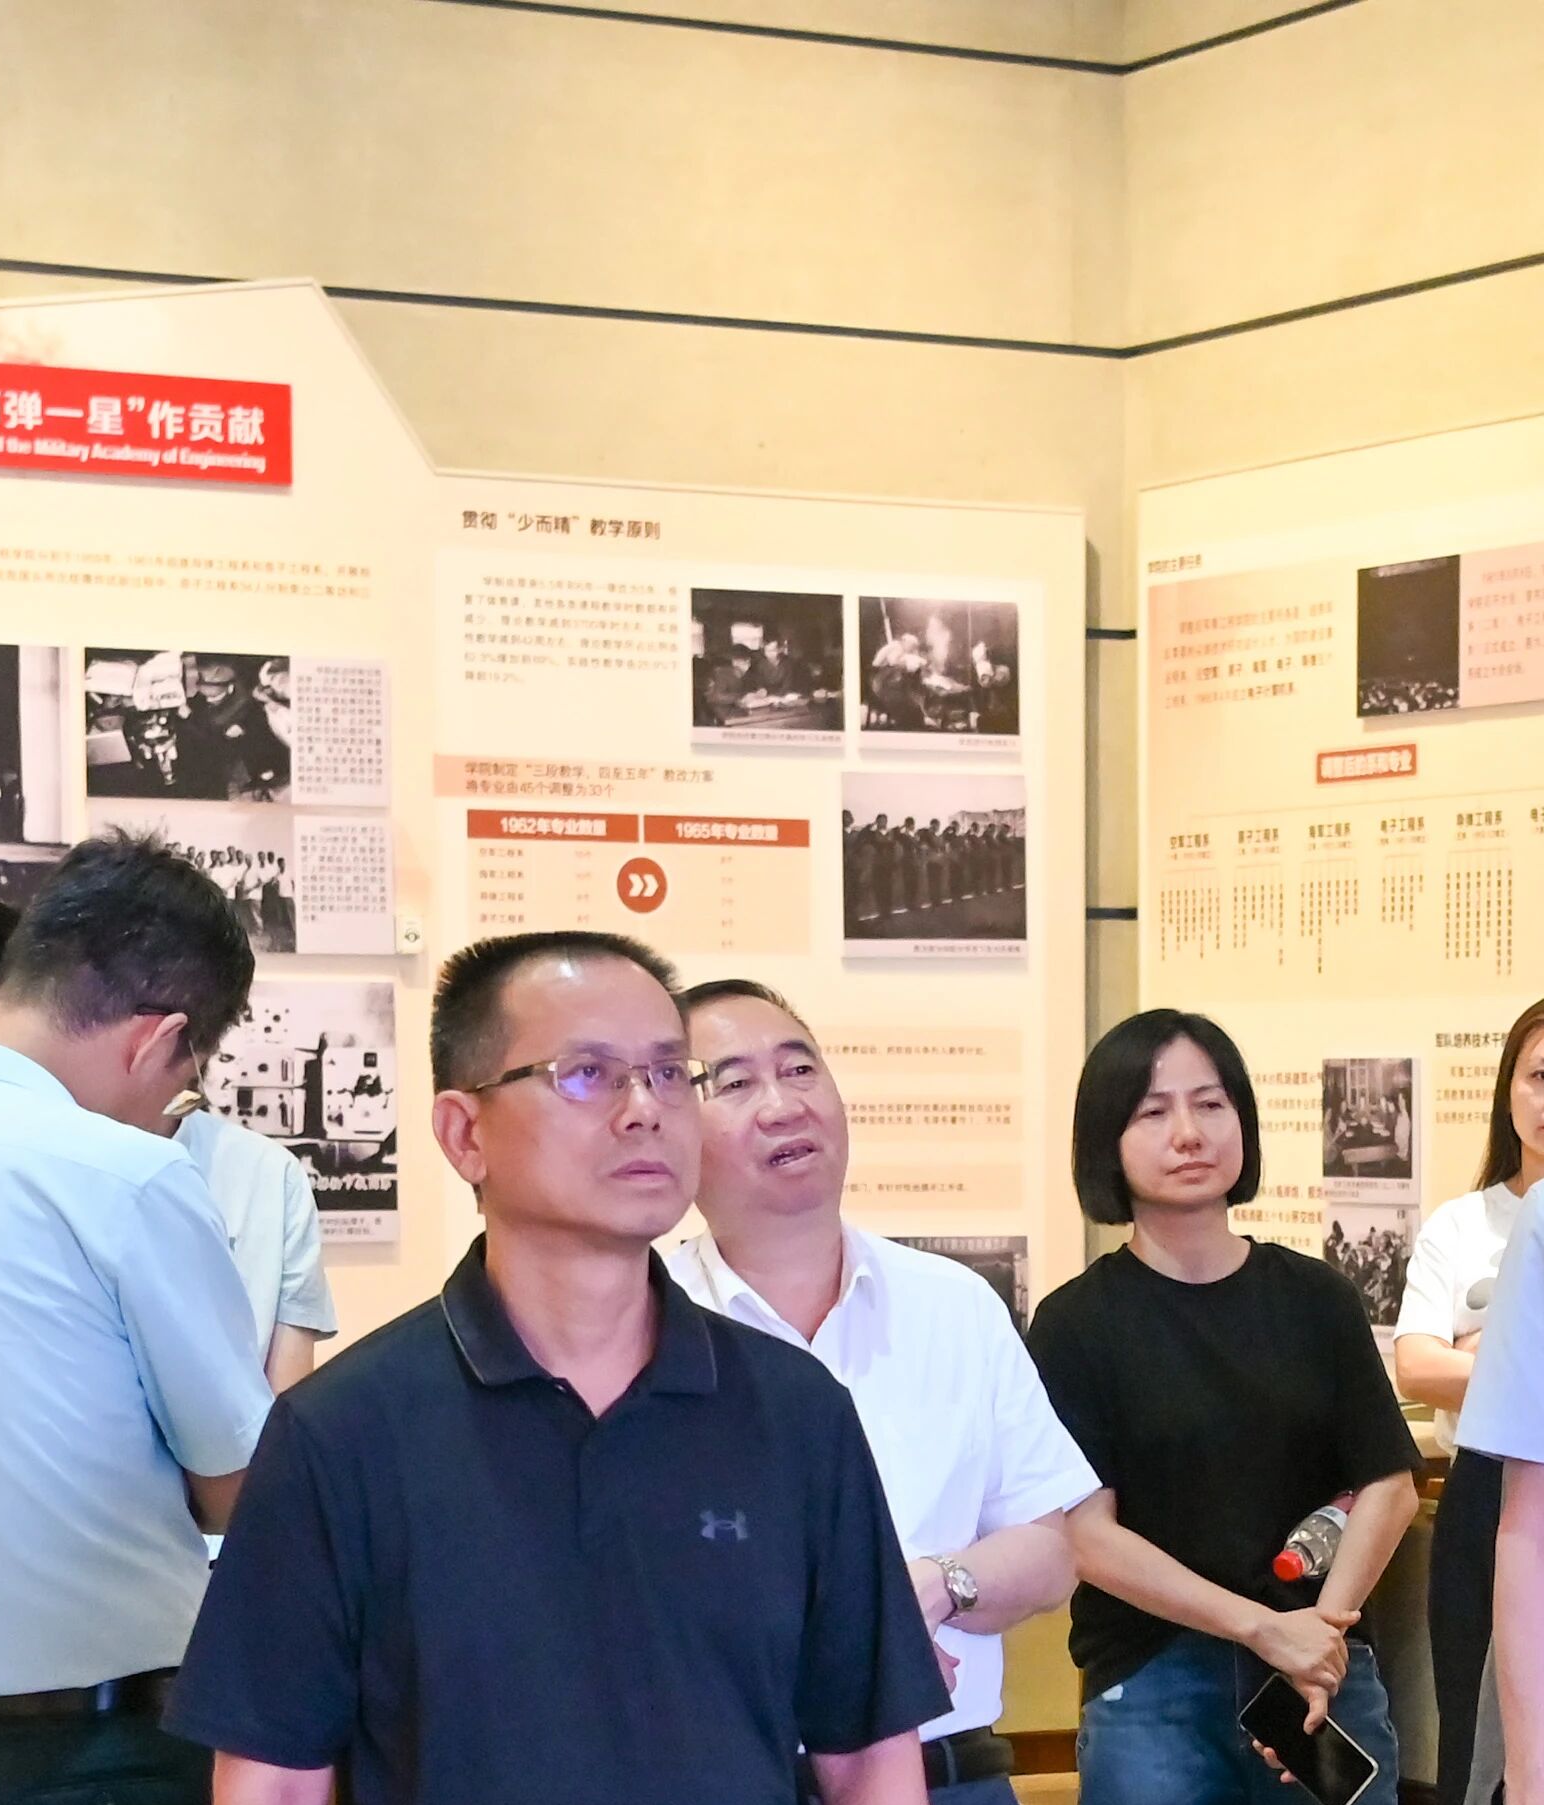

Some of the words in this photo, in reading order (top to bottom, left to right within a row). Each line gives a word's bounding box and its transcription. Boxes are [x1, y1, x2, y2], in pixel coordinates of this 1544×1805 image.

[6, 436, 33, 455] the
[91, 442, 160, 467] Academy
[162, 446, 177, 464] of
